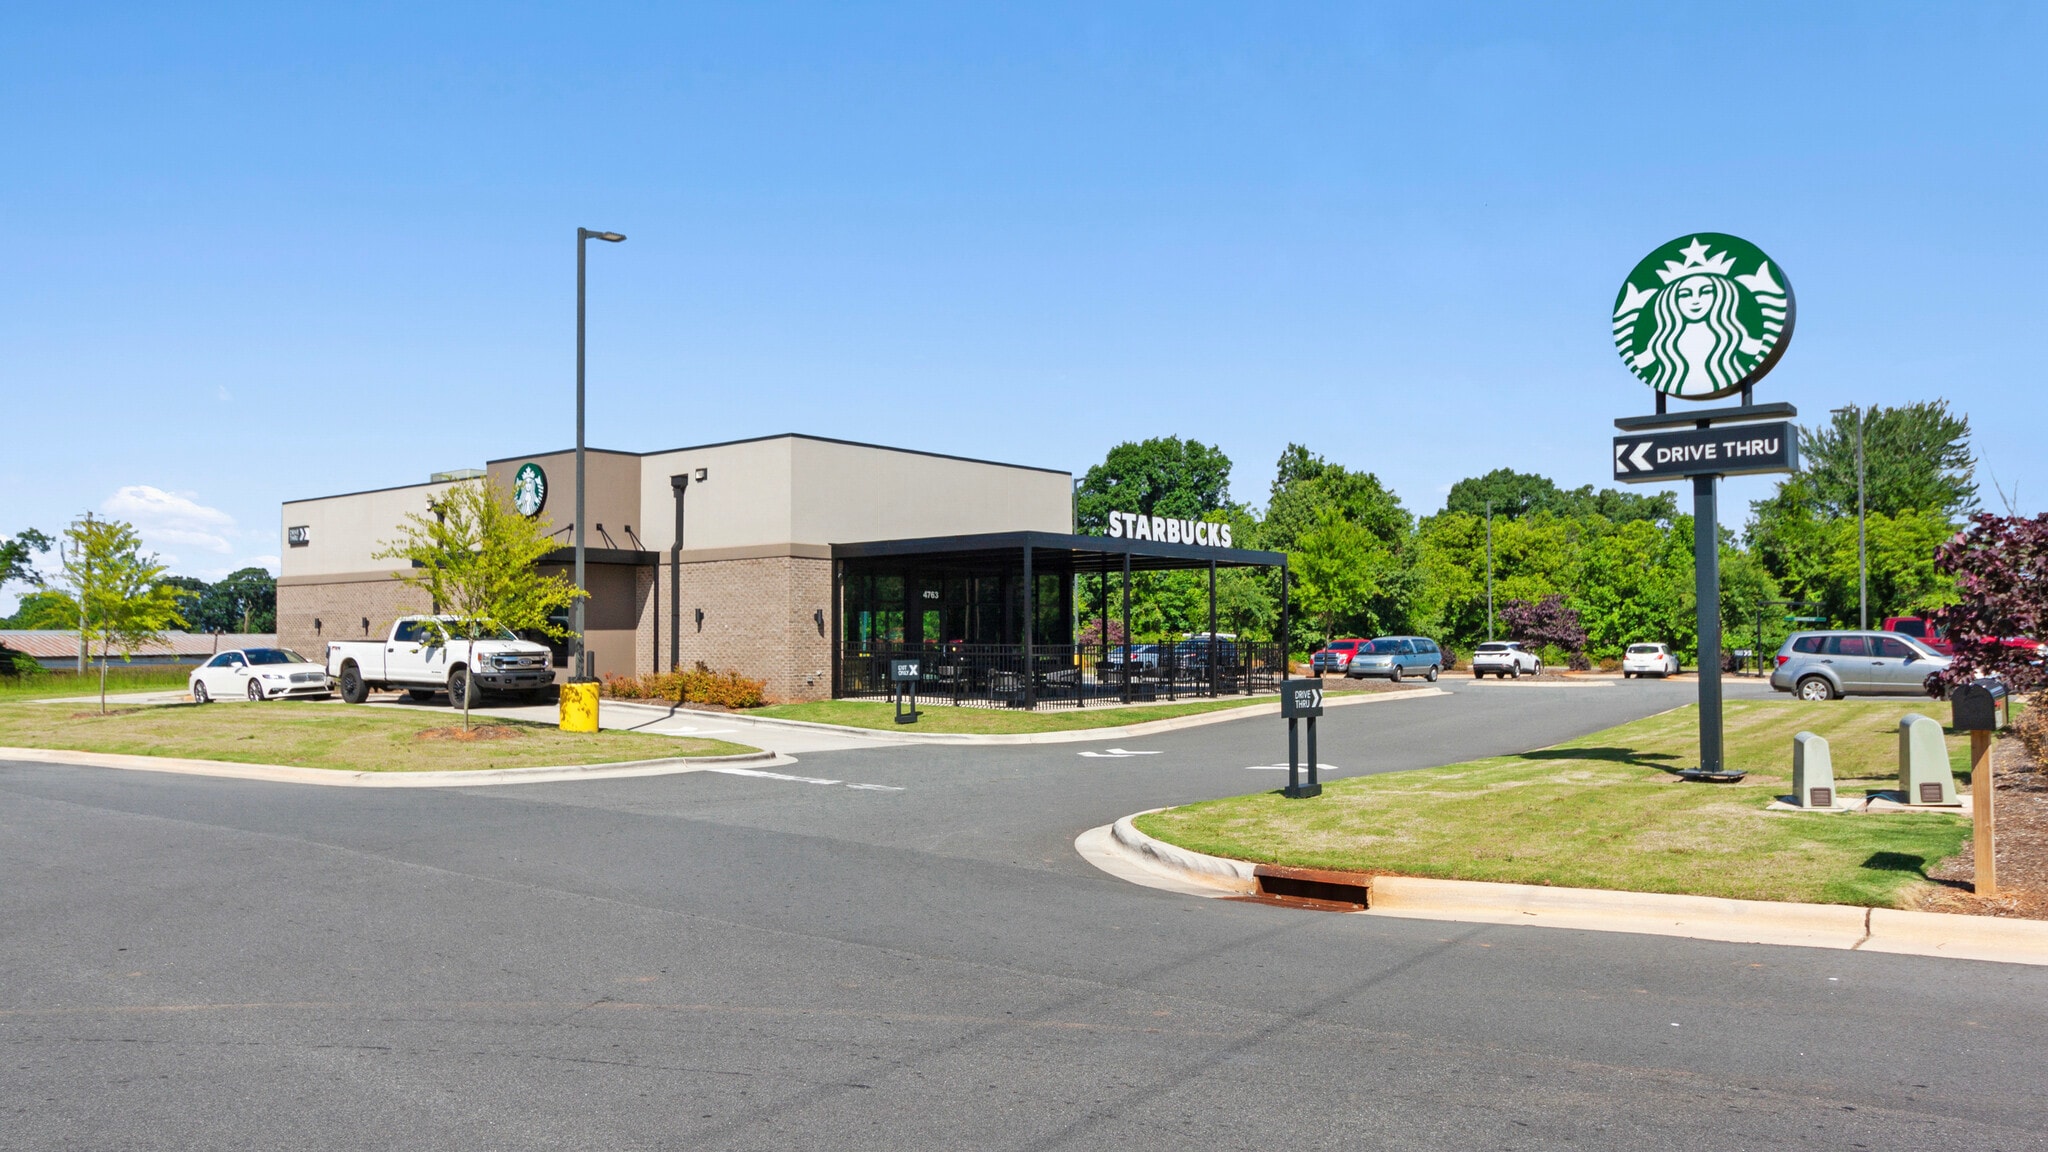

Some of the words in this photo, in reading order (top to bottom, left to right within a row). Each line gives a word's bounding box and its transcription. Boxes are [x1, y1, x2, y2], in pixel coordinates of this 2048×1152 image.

[1656, 444, 1717, 464] DRIVE
[1723, 438, 1779, 458] THRU
[1109, 510, 1232, 548] STARBUCKS
[922, 590, 939, 599] 4763
[1295, 690, 1311, 699] DRIVE
[1295, 700, 1310, 709] THRU
